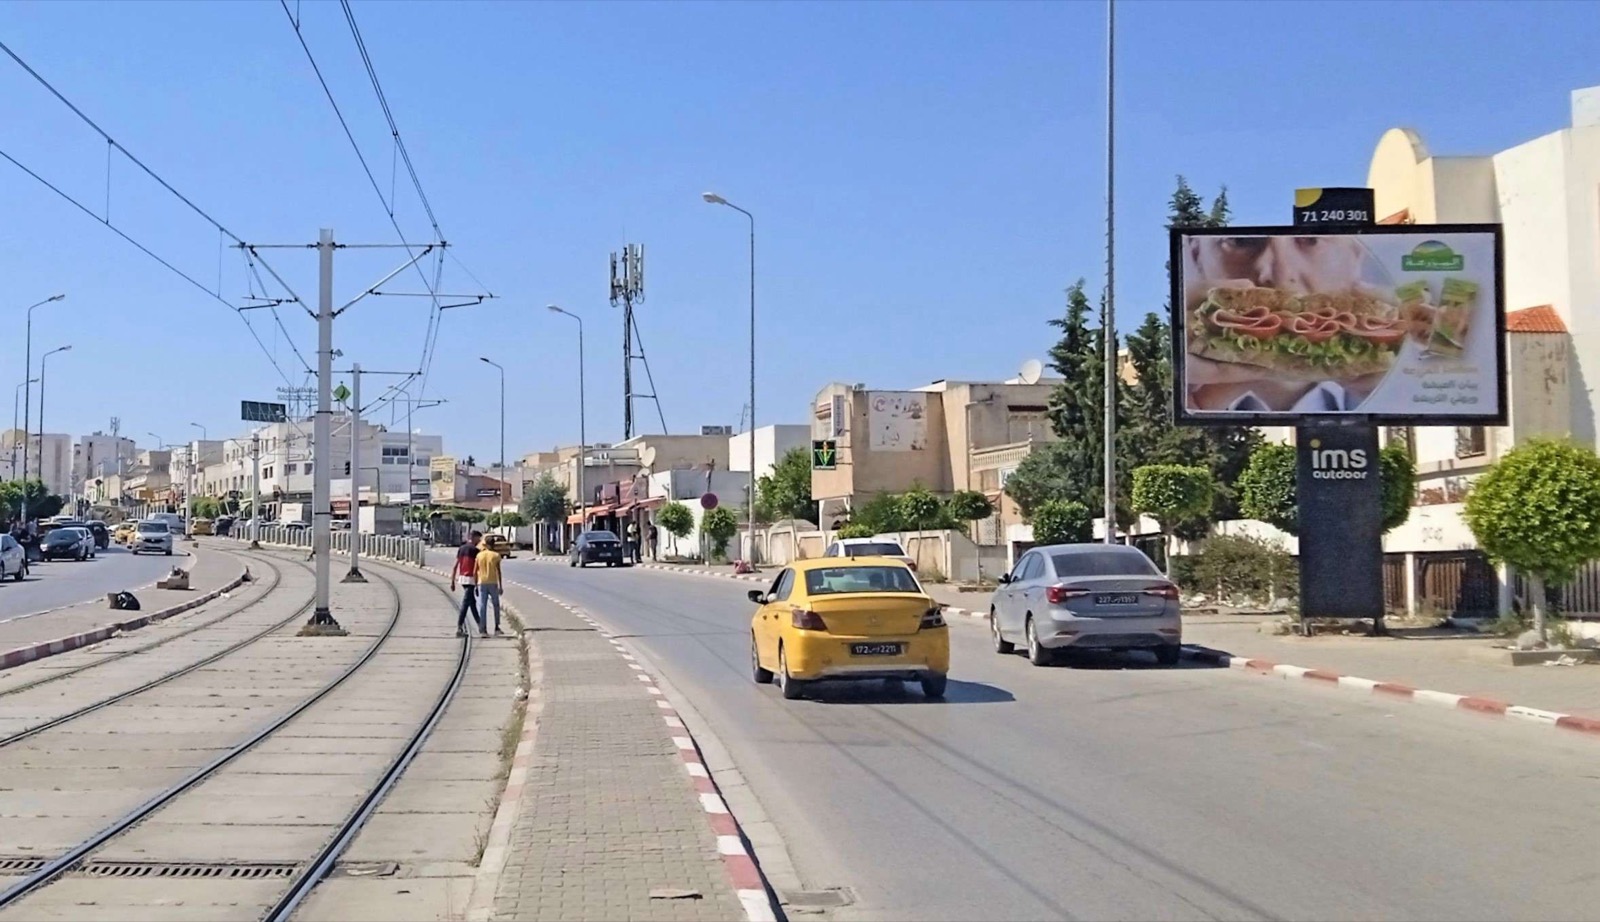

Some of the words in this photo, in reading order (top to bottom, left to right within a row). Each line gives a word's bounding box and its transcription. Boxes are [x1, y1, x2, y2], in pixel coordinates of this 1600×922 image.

[1302, 211, 1318, 222] 71
[1321, 210, 1345, 222] 240
[1347, 210, 1368, 221] 301
[1310, 438, 1368, 469] ims
[1312, 470, 1368, 480] outdoor
